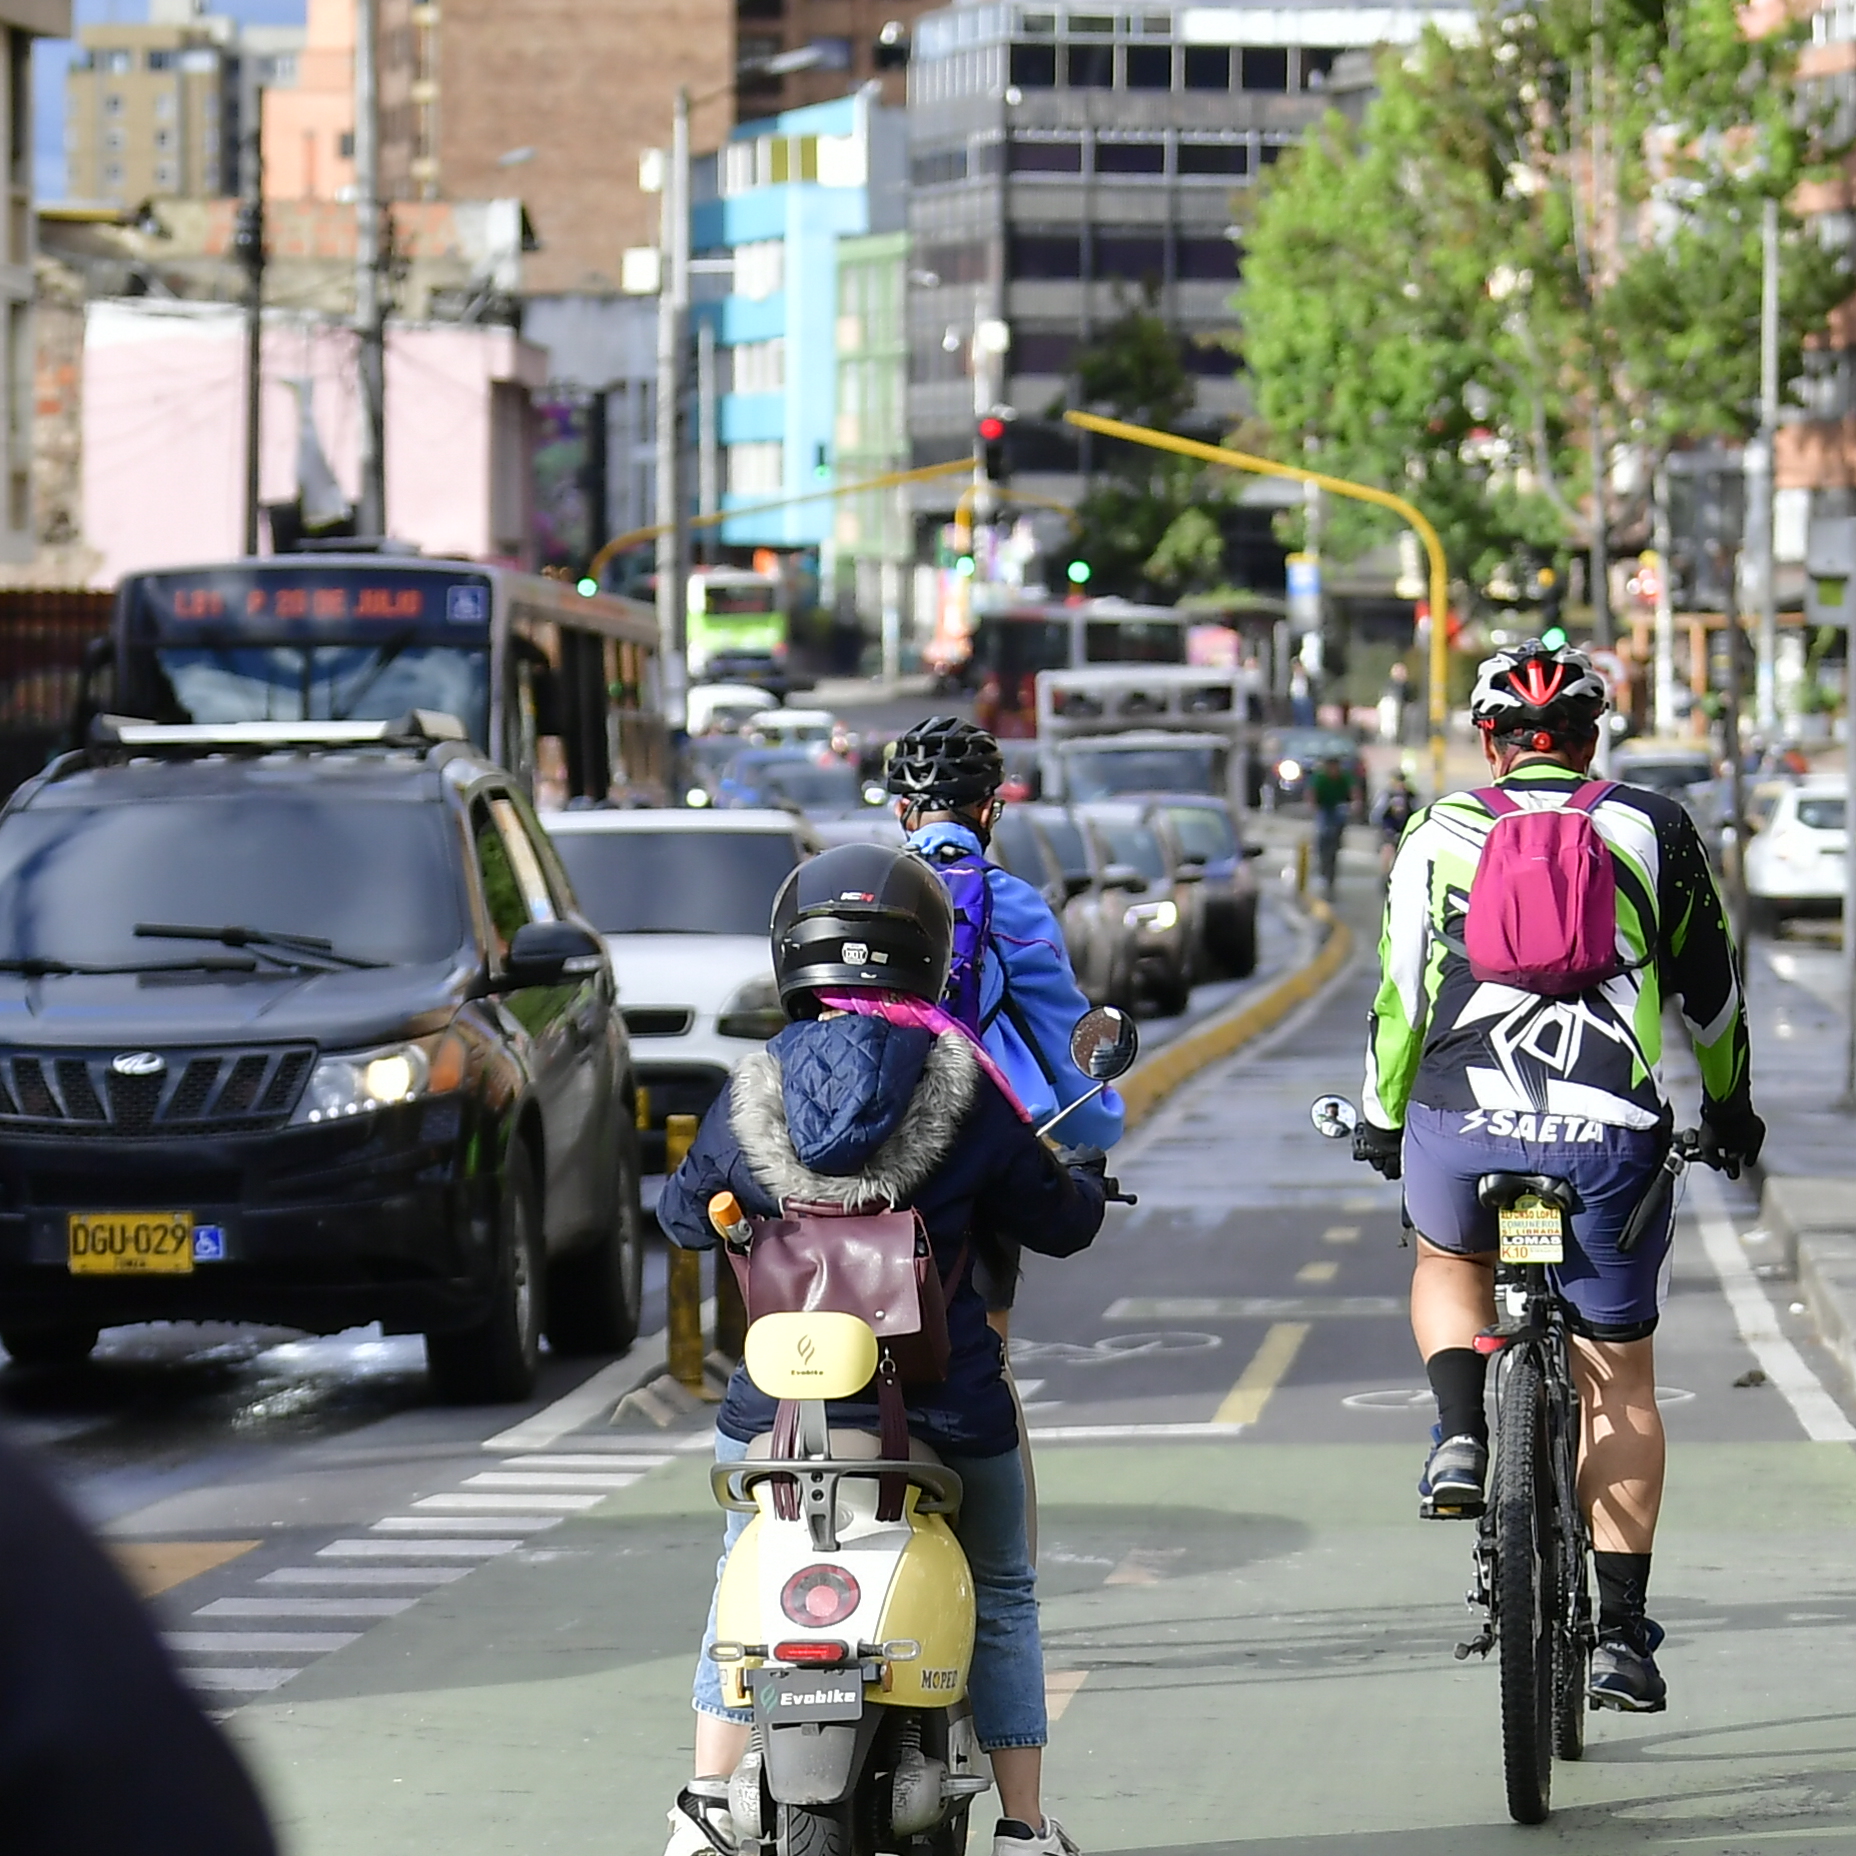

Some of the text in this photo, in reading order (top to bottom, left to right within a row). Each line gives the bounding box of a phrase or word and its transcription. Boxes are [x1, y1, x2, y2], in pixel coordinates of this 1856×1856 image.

[1487, 1109, 1604, 1143] SAETA
[1501, 1221, 1560, 1229] COMUNEROS
[1502, 1236, 1562, 1245] LOMAS
[1452, 1435, 1475, 1444] FILA
[1606, 1642, 1627, 1652] FILA
[921, 1669, 958, 1689] MOPED
[780, 1689, 857, 1706] Evobike
